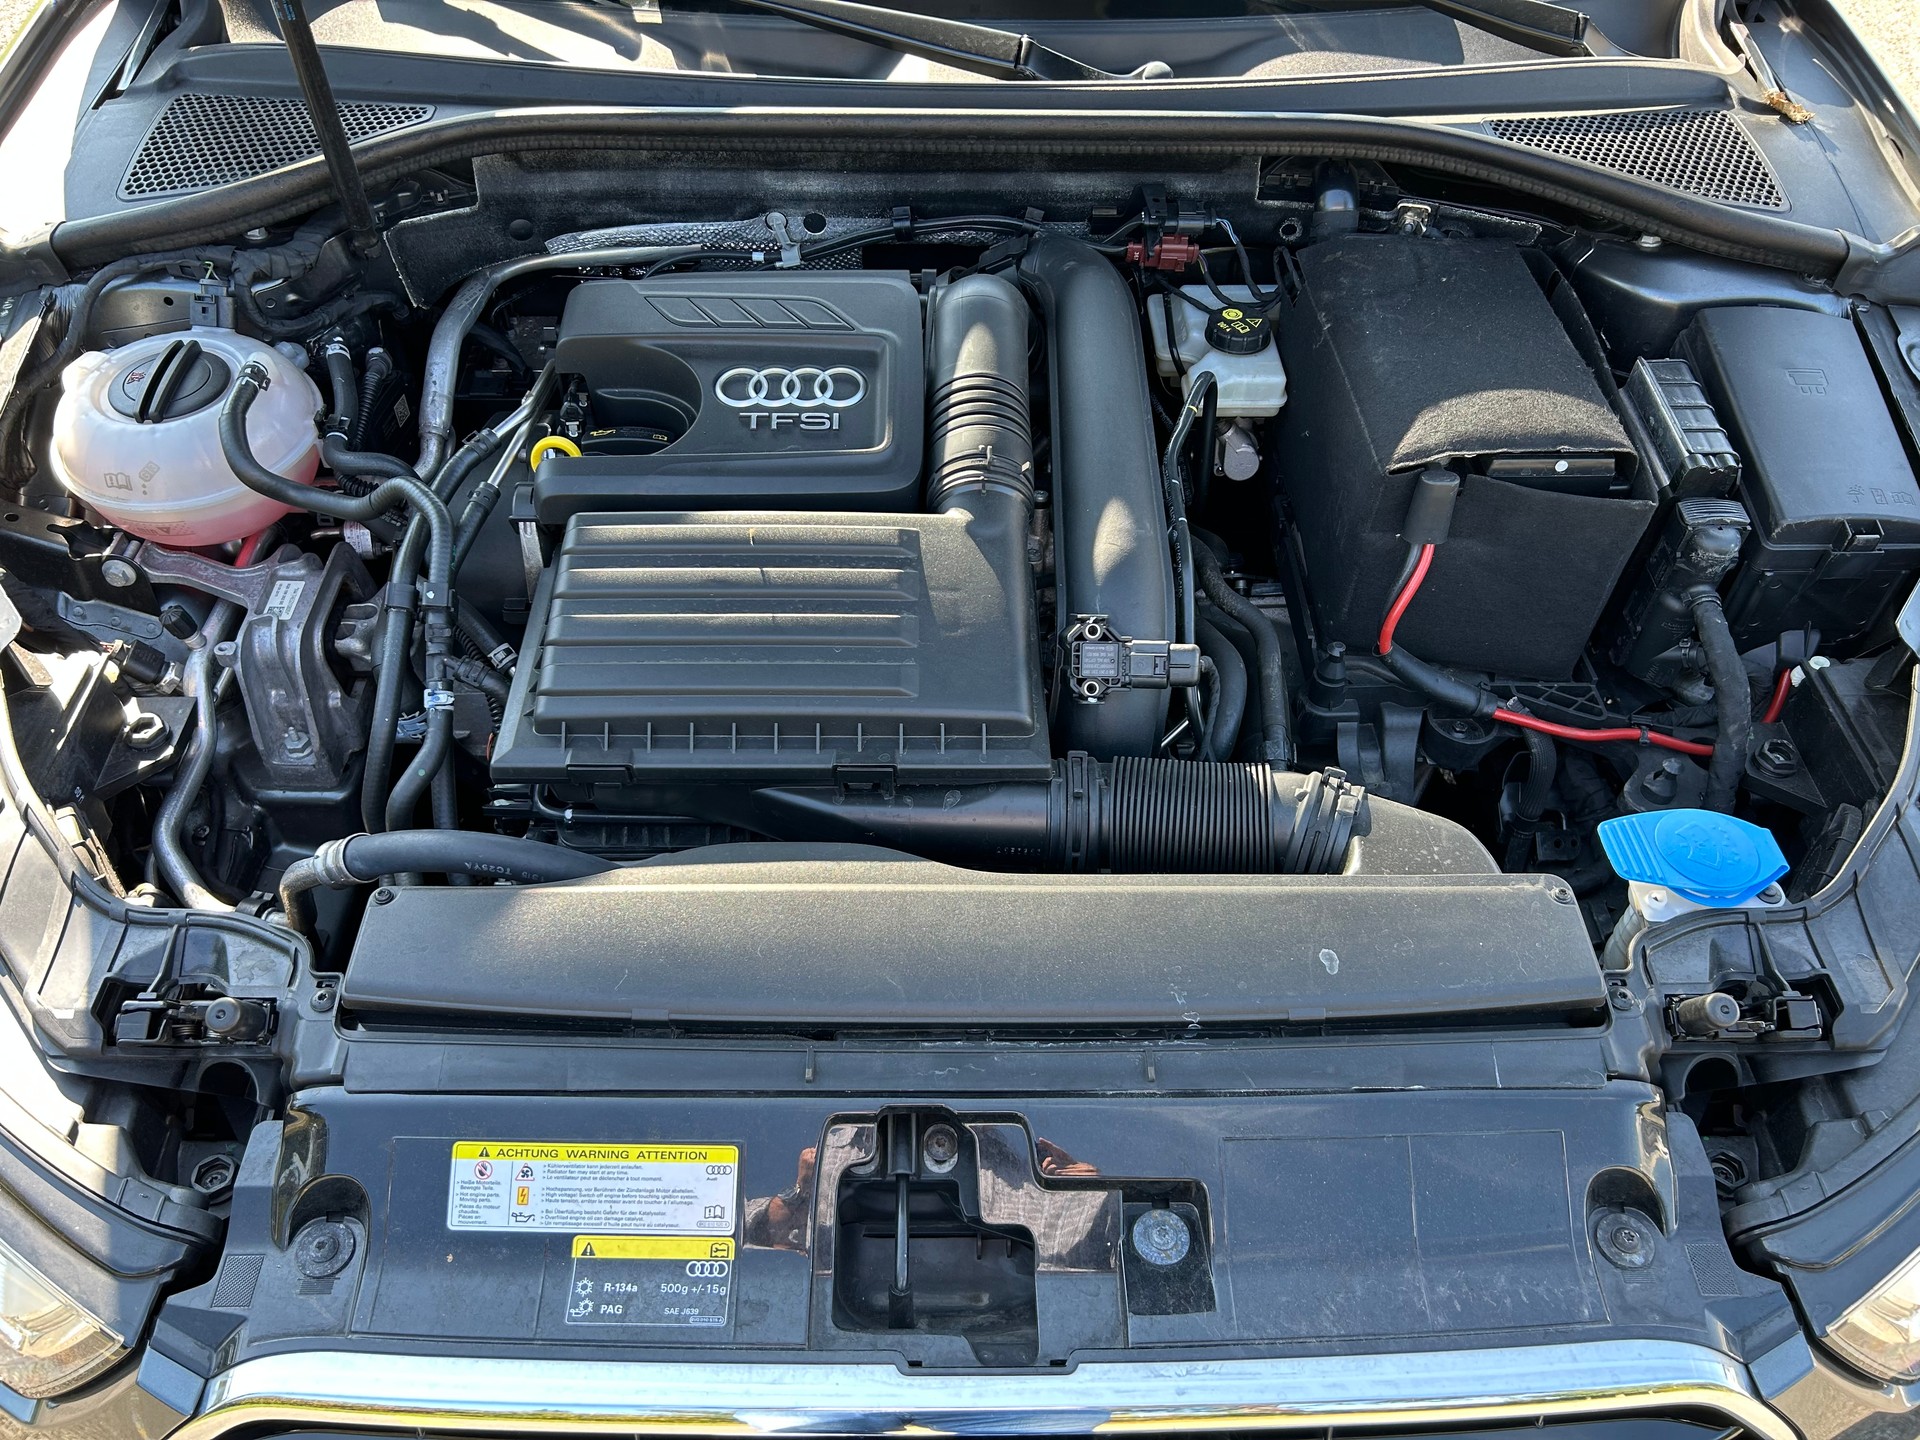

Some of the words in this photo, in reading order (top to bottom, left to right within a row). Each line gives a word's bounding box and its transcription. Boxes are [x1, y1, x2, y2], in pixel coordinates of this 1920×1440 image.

[739, 412, 839, 430] TFSI
[496, 1148, 558, 1158] ACHTUNG
[566, 1150, 630, 1159] WARNING
[636, 1151, 708, 1160] ATTENTION
[604, 1282, 638, 1292] R-134a
[660, 1283, 688, 1295] 500g
[600, 1304, 624, 1314] PAG
